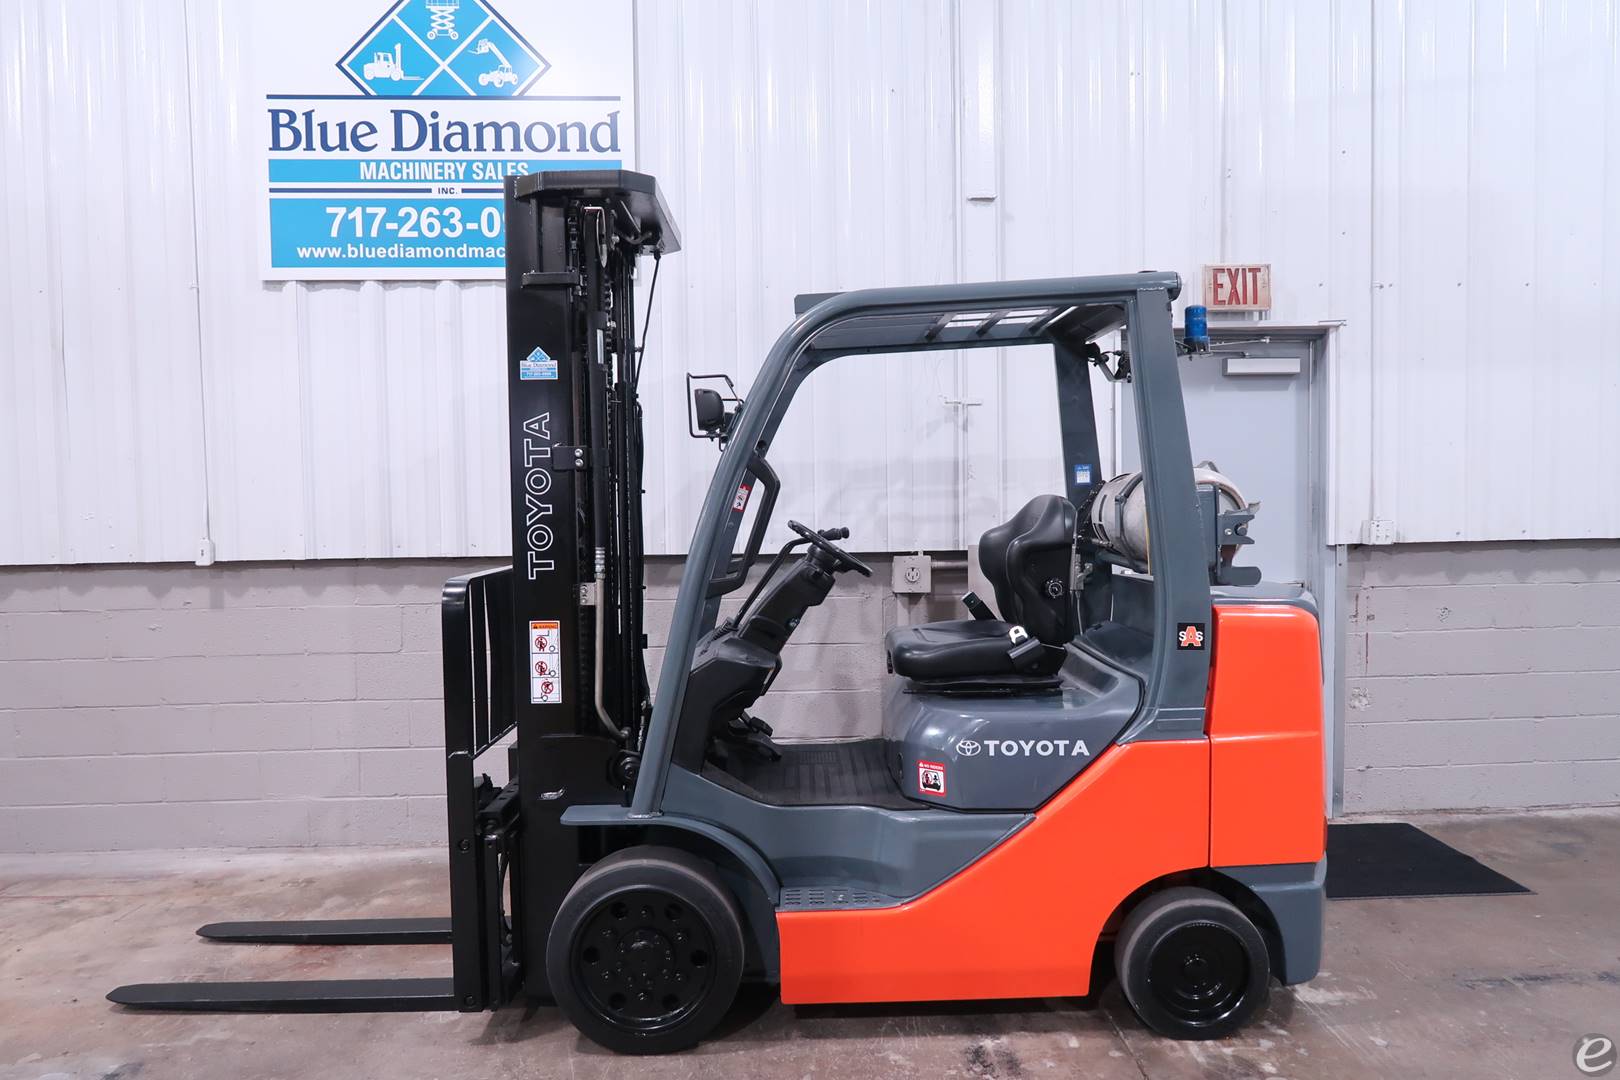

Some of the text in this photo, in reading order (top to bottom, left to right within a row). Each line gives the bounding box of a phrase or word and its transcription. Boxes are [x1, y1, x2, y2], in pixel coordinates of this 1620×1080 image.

[267, 109, 621, 153] Blue Diamond
[360, 161, 528, 180] MACHINERY SALES
[438, 187, 458, 195] INC.
[326, 206, 505, 238] 717-263-0
[1212, 268, 1261, 305] EXIT
[524, 412, 555, 580] TOYOTA
[984, 740, 1090, 756] TOYOTA
